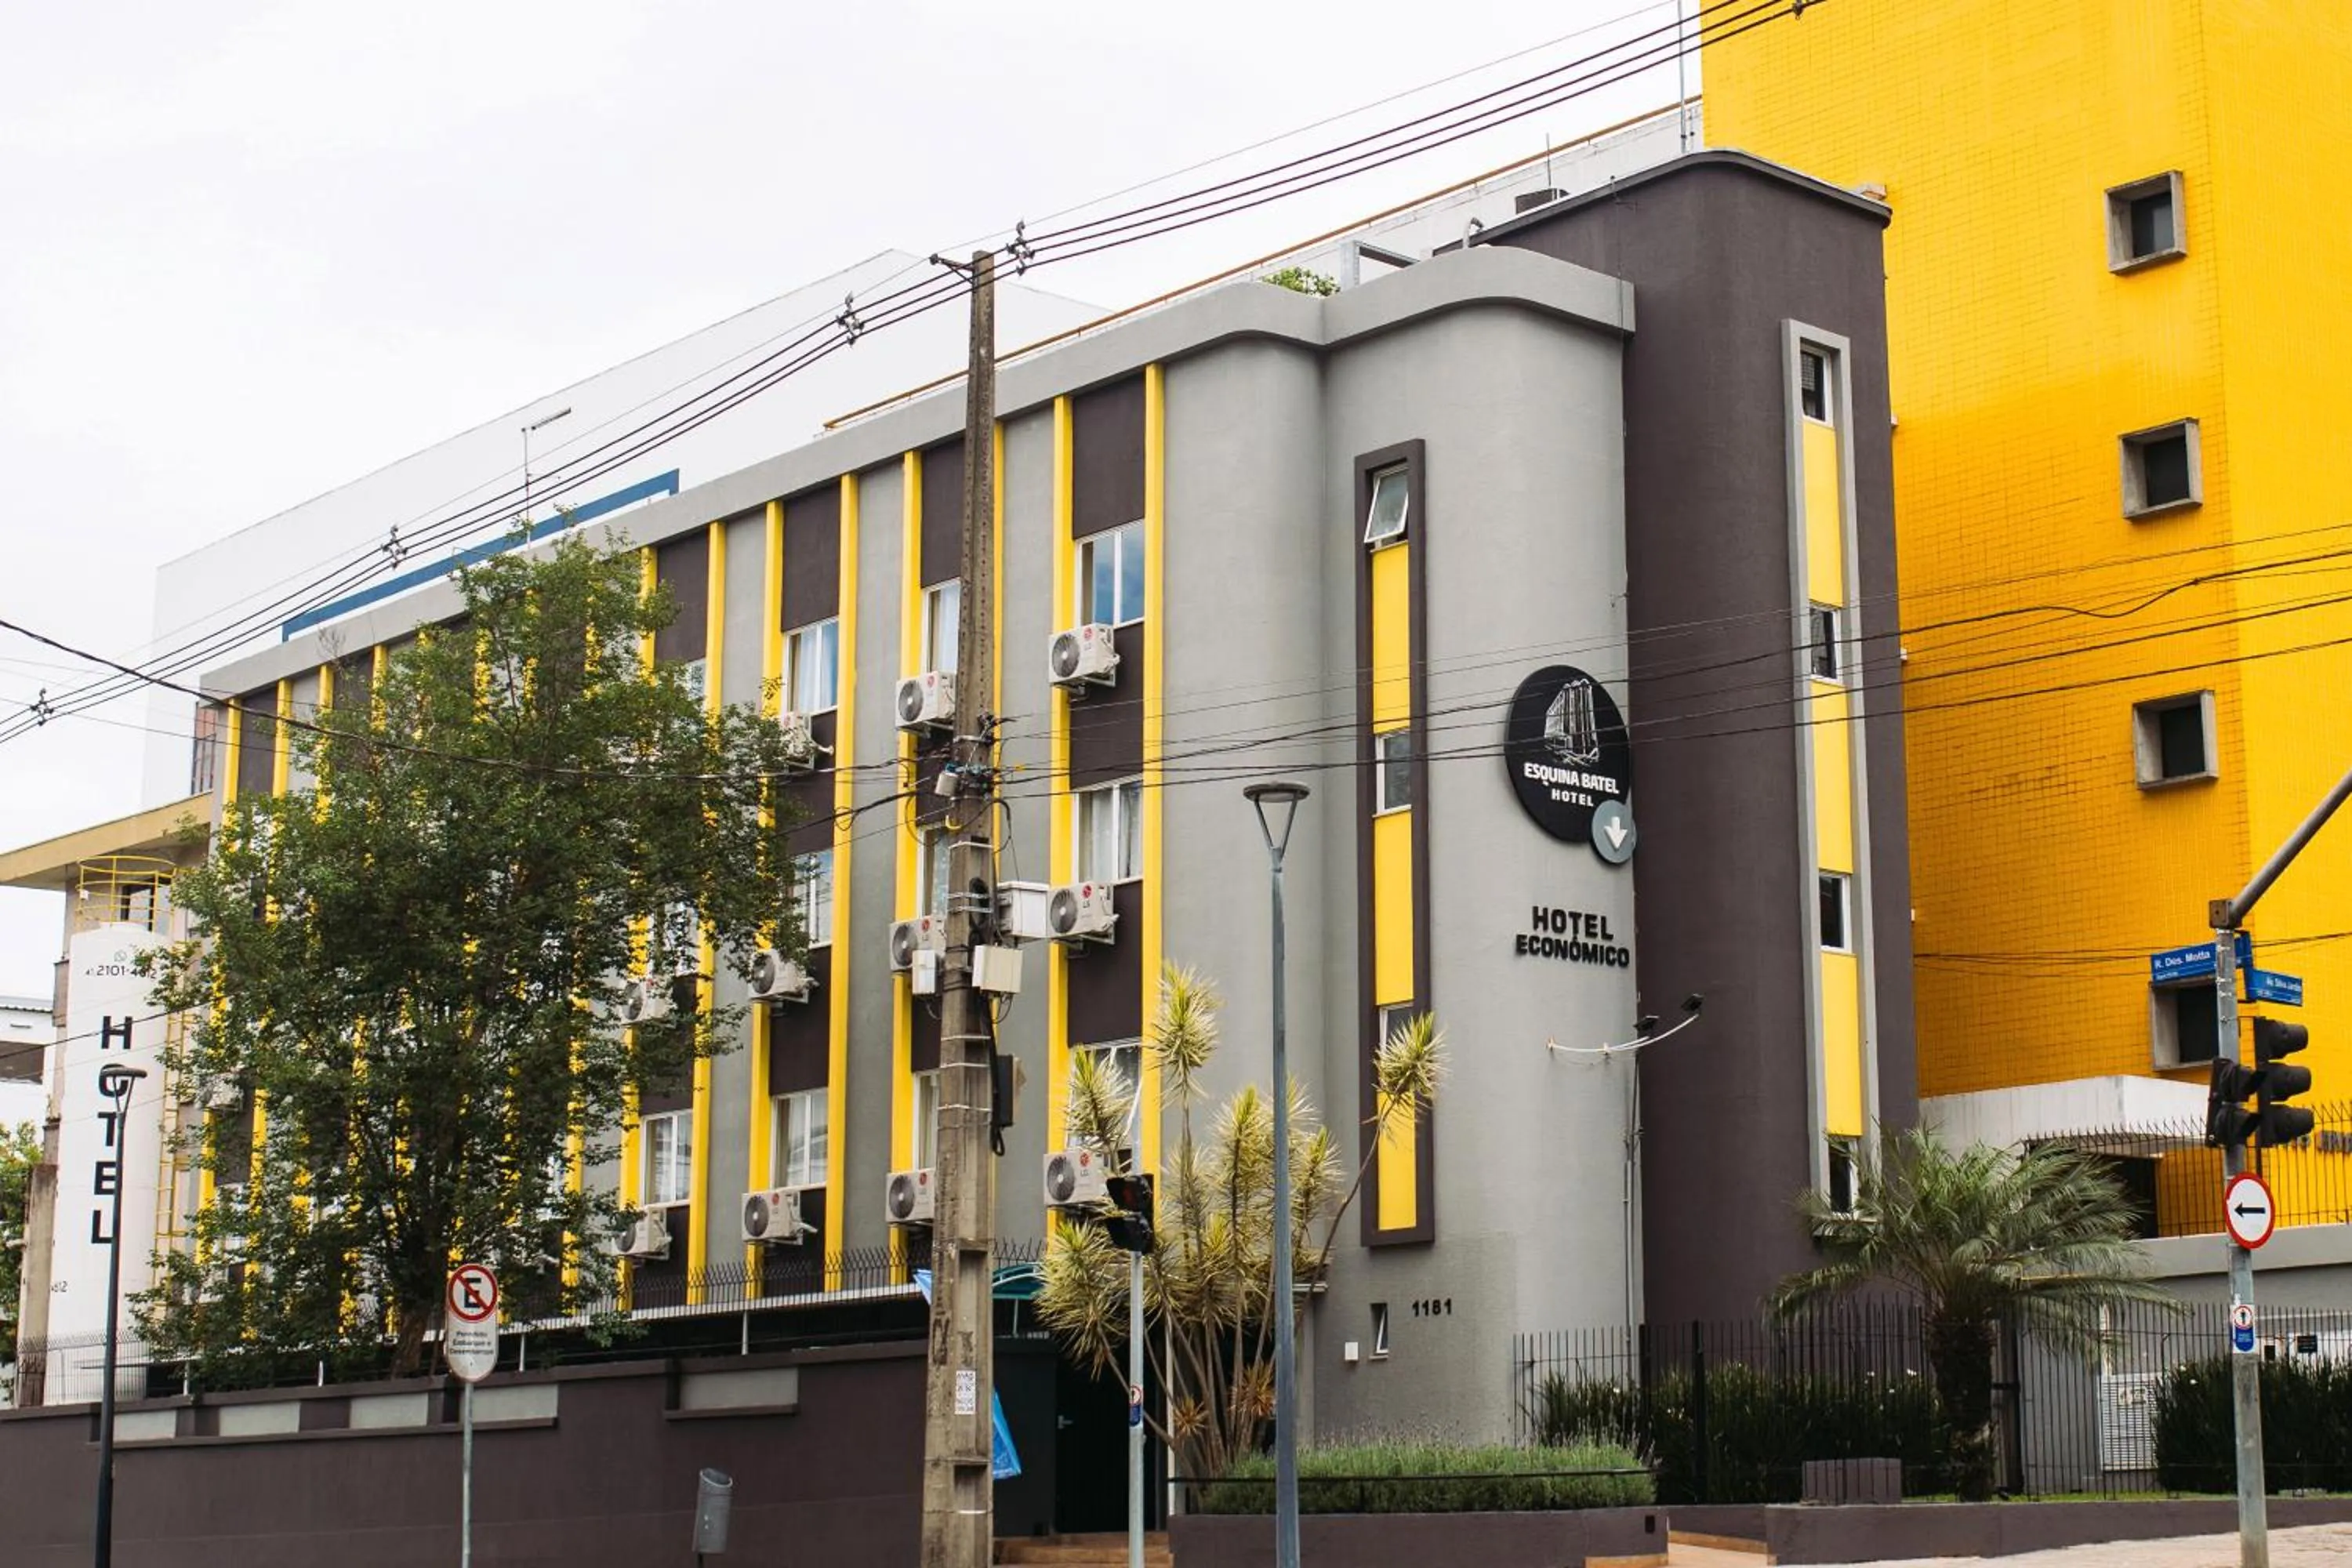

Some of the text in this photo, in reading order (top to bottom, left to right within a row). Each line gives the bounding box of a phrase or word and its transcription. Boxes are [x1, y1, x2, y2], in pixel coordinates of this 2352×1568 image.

[1523, 761, 1621, 794] ESQUINA BATEL
[1551, 787, 1594, 807] HOTEL
[1532, 906, 1614, 941] HOTEL
[1515, 934, 1630, 967] ECONÔMICO
[91, 1015, 132, 1244] HOTEL
[1412, 1298, 1452, 1318] 1181
